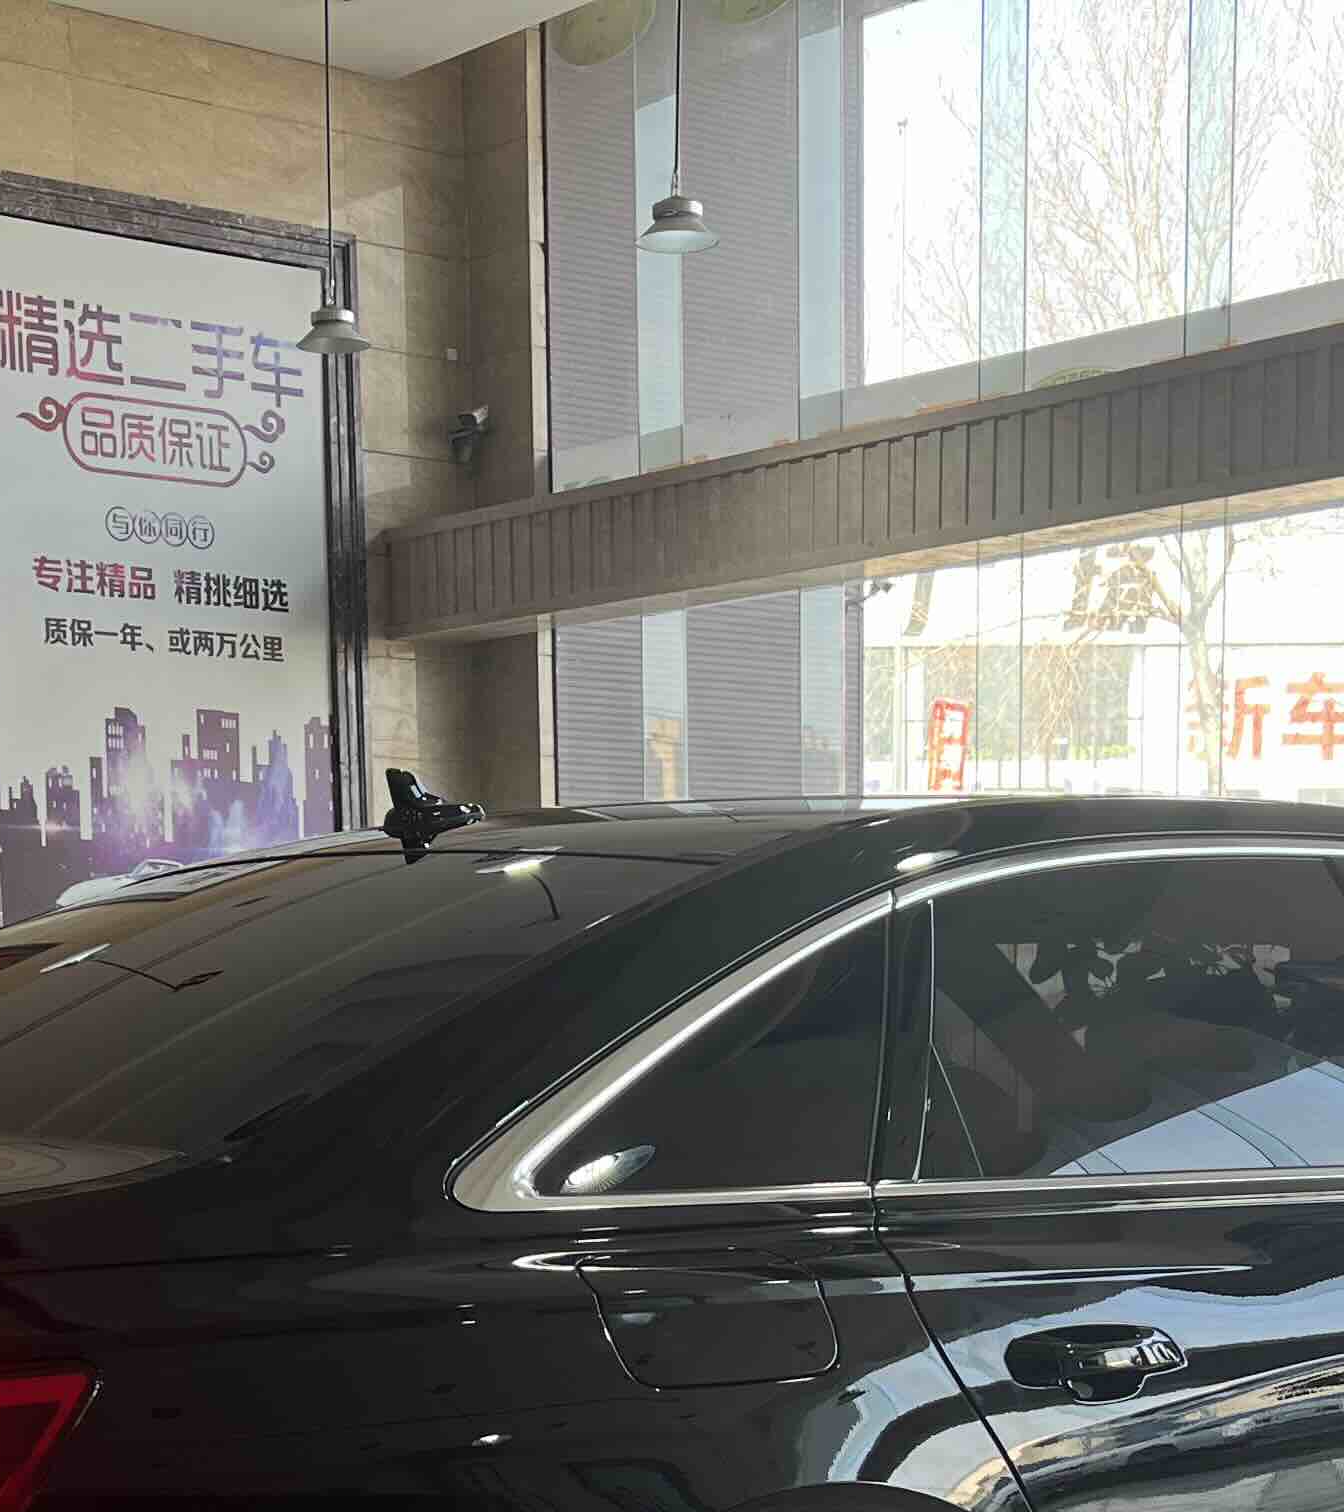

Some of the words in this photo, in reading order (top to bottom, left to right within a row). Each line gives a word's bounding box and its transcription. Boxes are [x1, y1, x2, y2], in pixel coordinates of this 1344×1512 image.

[80, 407, 233, 473] 品质保证
[32, 554, 157, 601] 专注精品
[173, 568, 290, 615] 精挑细选
